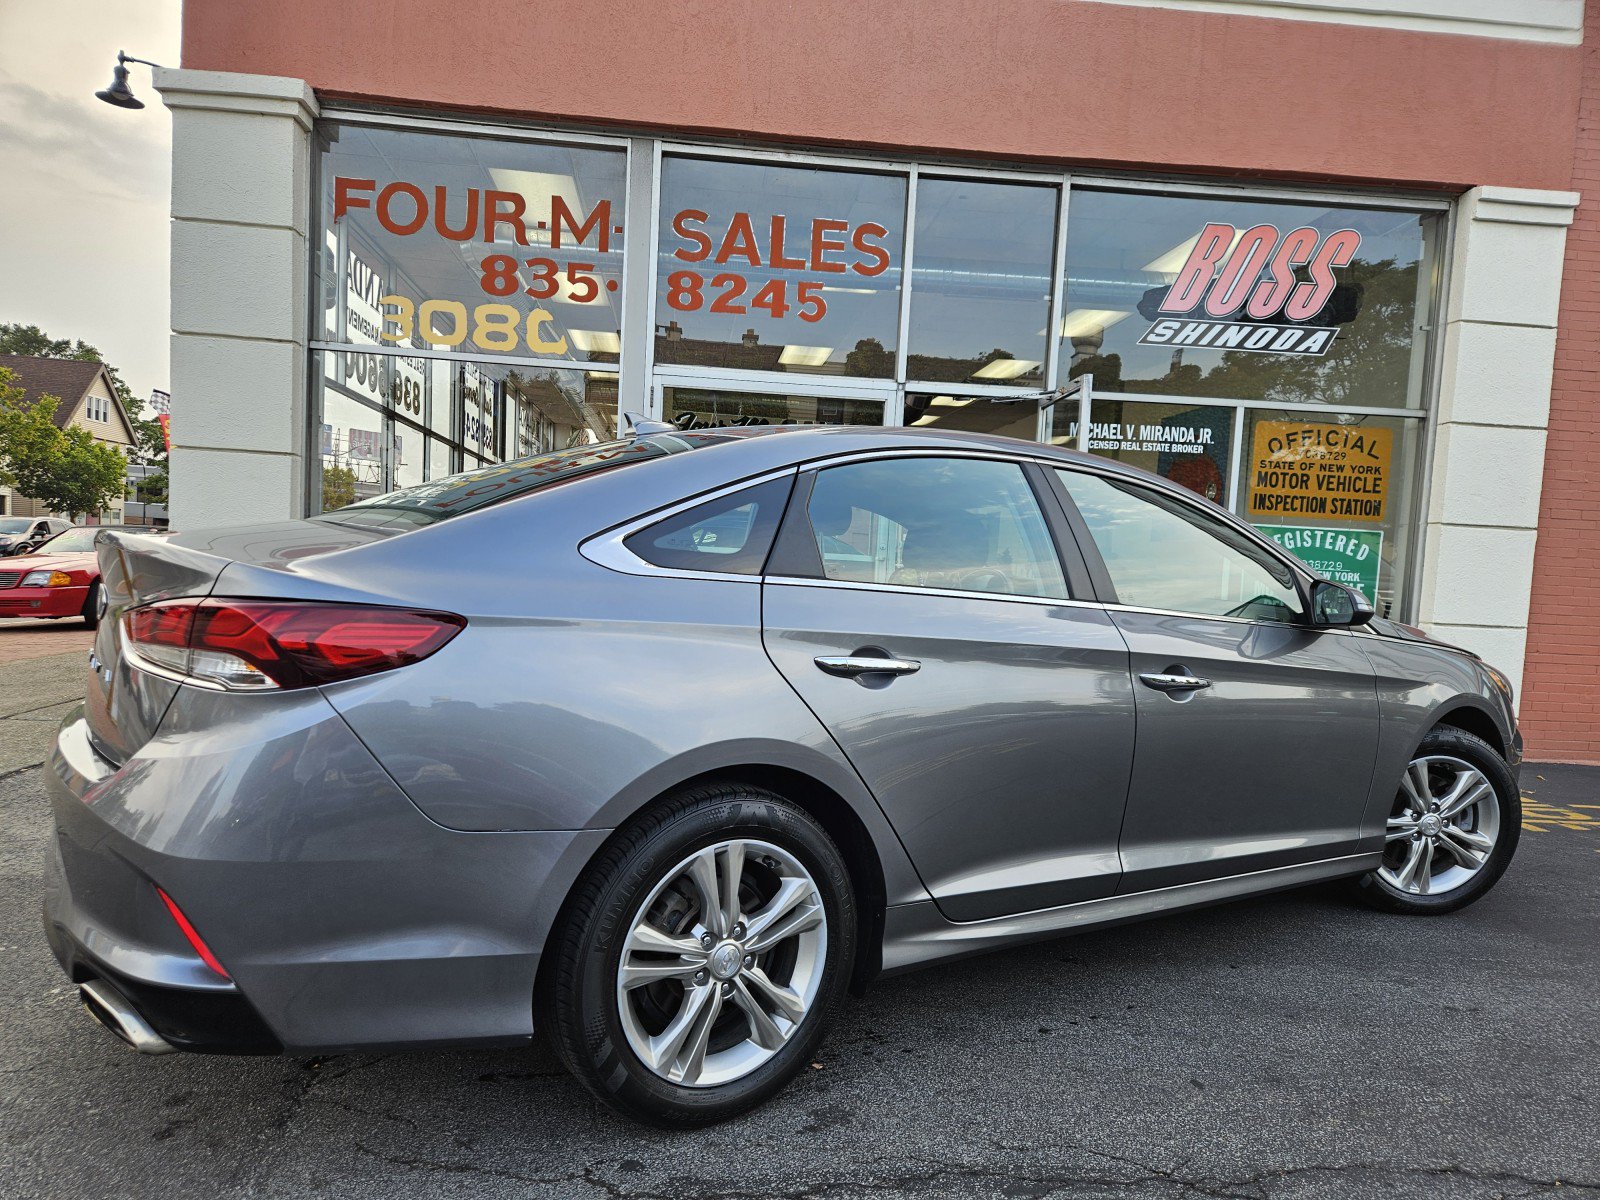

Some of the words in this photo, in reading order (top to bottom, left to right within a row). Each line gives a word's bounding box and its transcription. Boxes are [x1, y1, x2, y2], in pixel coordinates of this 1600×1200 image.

[672, 208, 891, 277] SALES
[1158, 222, 1362, 321] BOSS
[666, 270, 827, 323] 8245
[1146, 320, 1331, 352] SHINODA
[1070, 422, 1123, 440] MCHAEL
[1126, 424, 1137, 440] V.
[1140, 425, 1196, 442] MIRANDA
[1198, 428, 1215, 444] JR.
[1268, 429, 1379, 460] OFFICIAL
[1088, 440, 1119, 450] CENSED
[1121, 441, 1141, 451] REAL
[1142, 442, 1170, 452] ESTATE
[1171, 443, 1204, 454] BROKER
[1260, 459, 1295, 471] STATE
[1300, 461, 1315, 471] OF
[1319, 463, 1346, 473] NEW
[1350, 464, 1382, 475] YORK
[1256, 470, 1311, 490] MOTOR
[1316, 473, 1383, 494] VEHICLE
[1253, 493, 1327, 514] INSPECTION
[1329, 497, 1382, 517] STATION
[1273, 530, 1370, 561] EGISTERED
[1335, 571, 1361, 582] YORK
